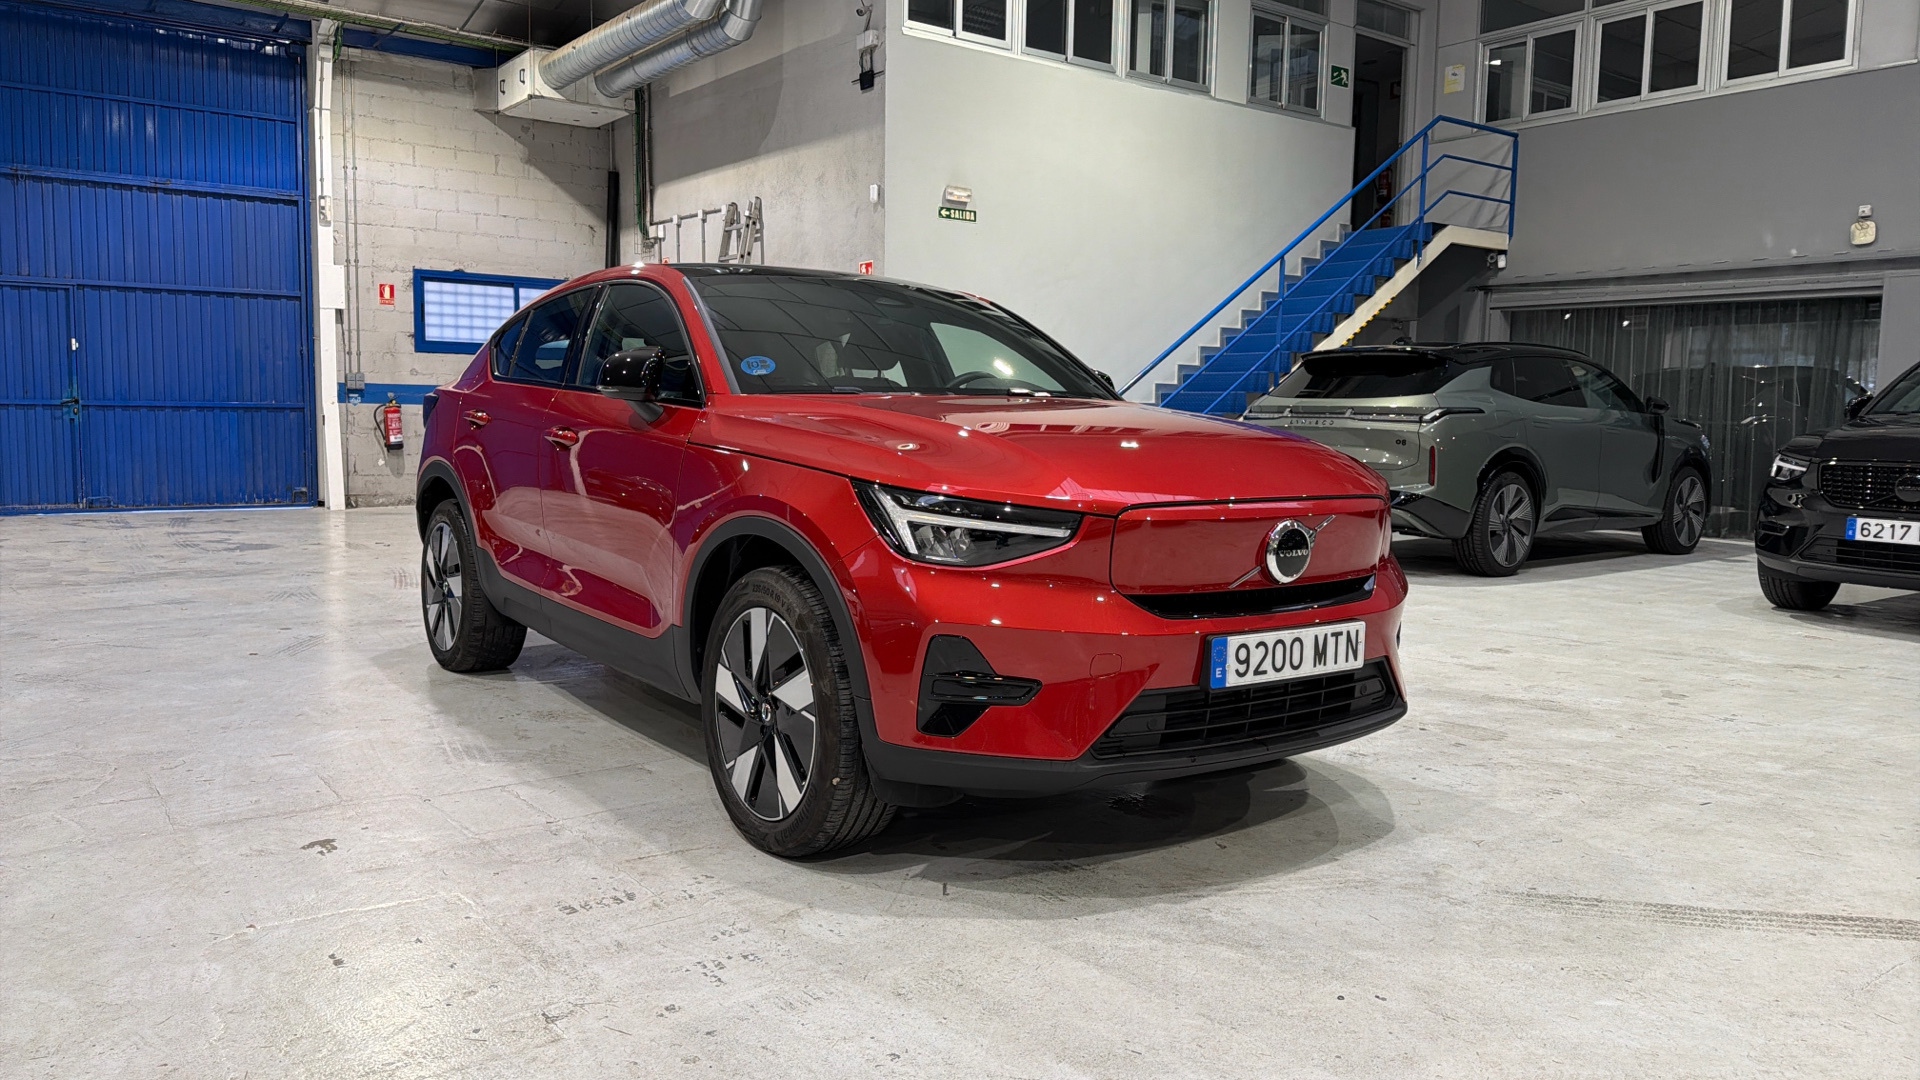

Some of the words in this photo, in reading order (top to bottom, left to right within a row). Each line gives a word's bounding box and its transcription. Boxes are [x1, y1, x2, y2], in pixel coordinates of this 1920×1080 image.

[950, 209, 975, 221] SALIDA
[1860, 521, 1912, 541] 6217
[1278, 549, 1309, 557] VOLVO
[1235, 637, 1304, 678] 9200
[1313, 629, 1360, 668] MTN
[1215, 667, 1223, 678] E
